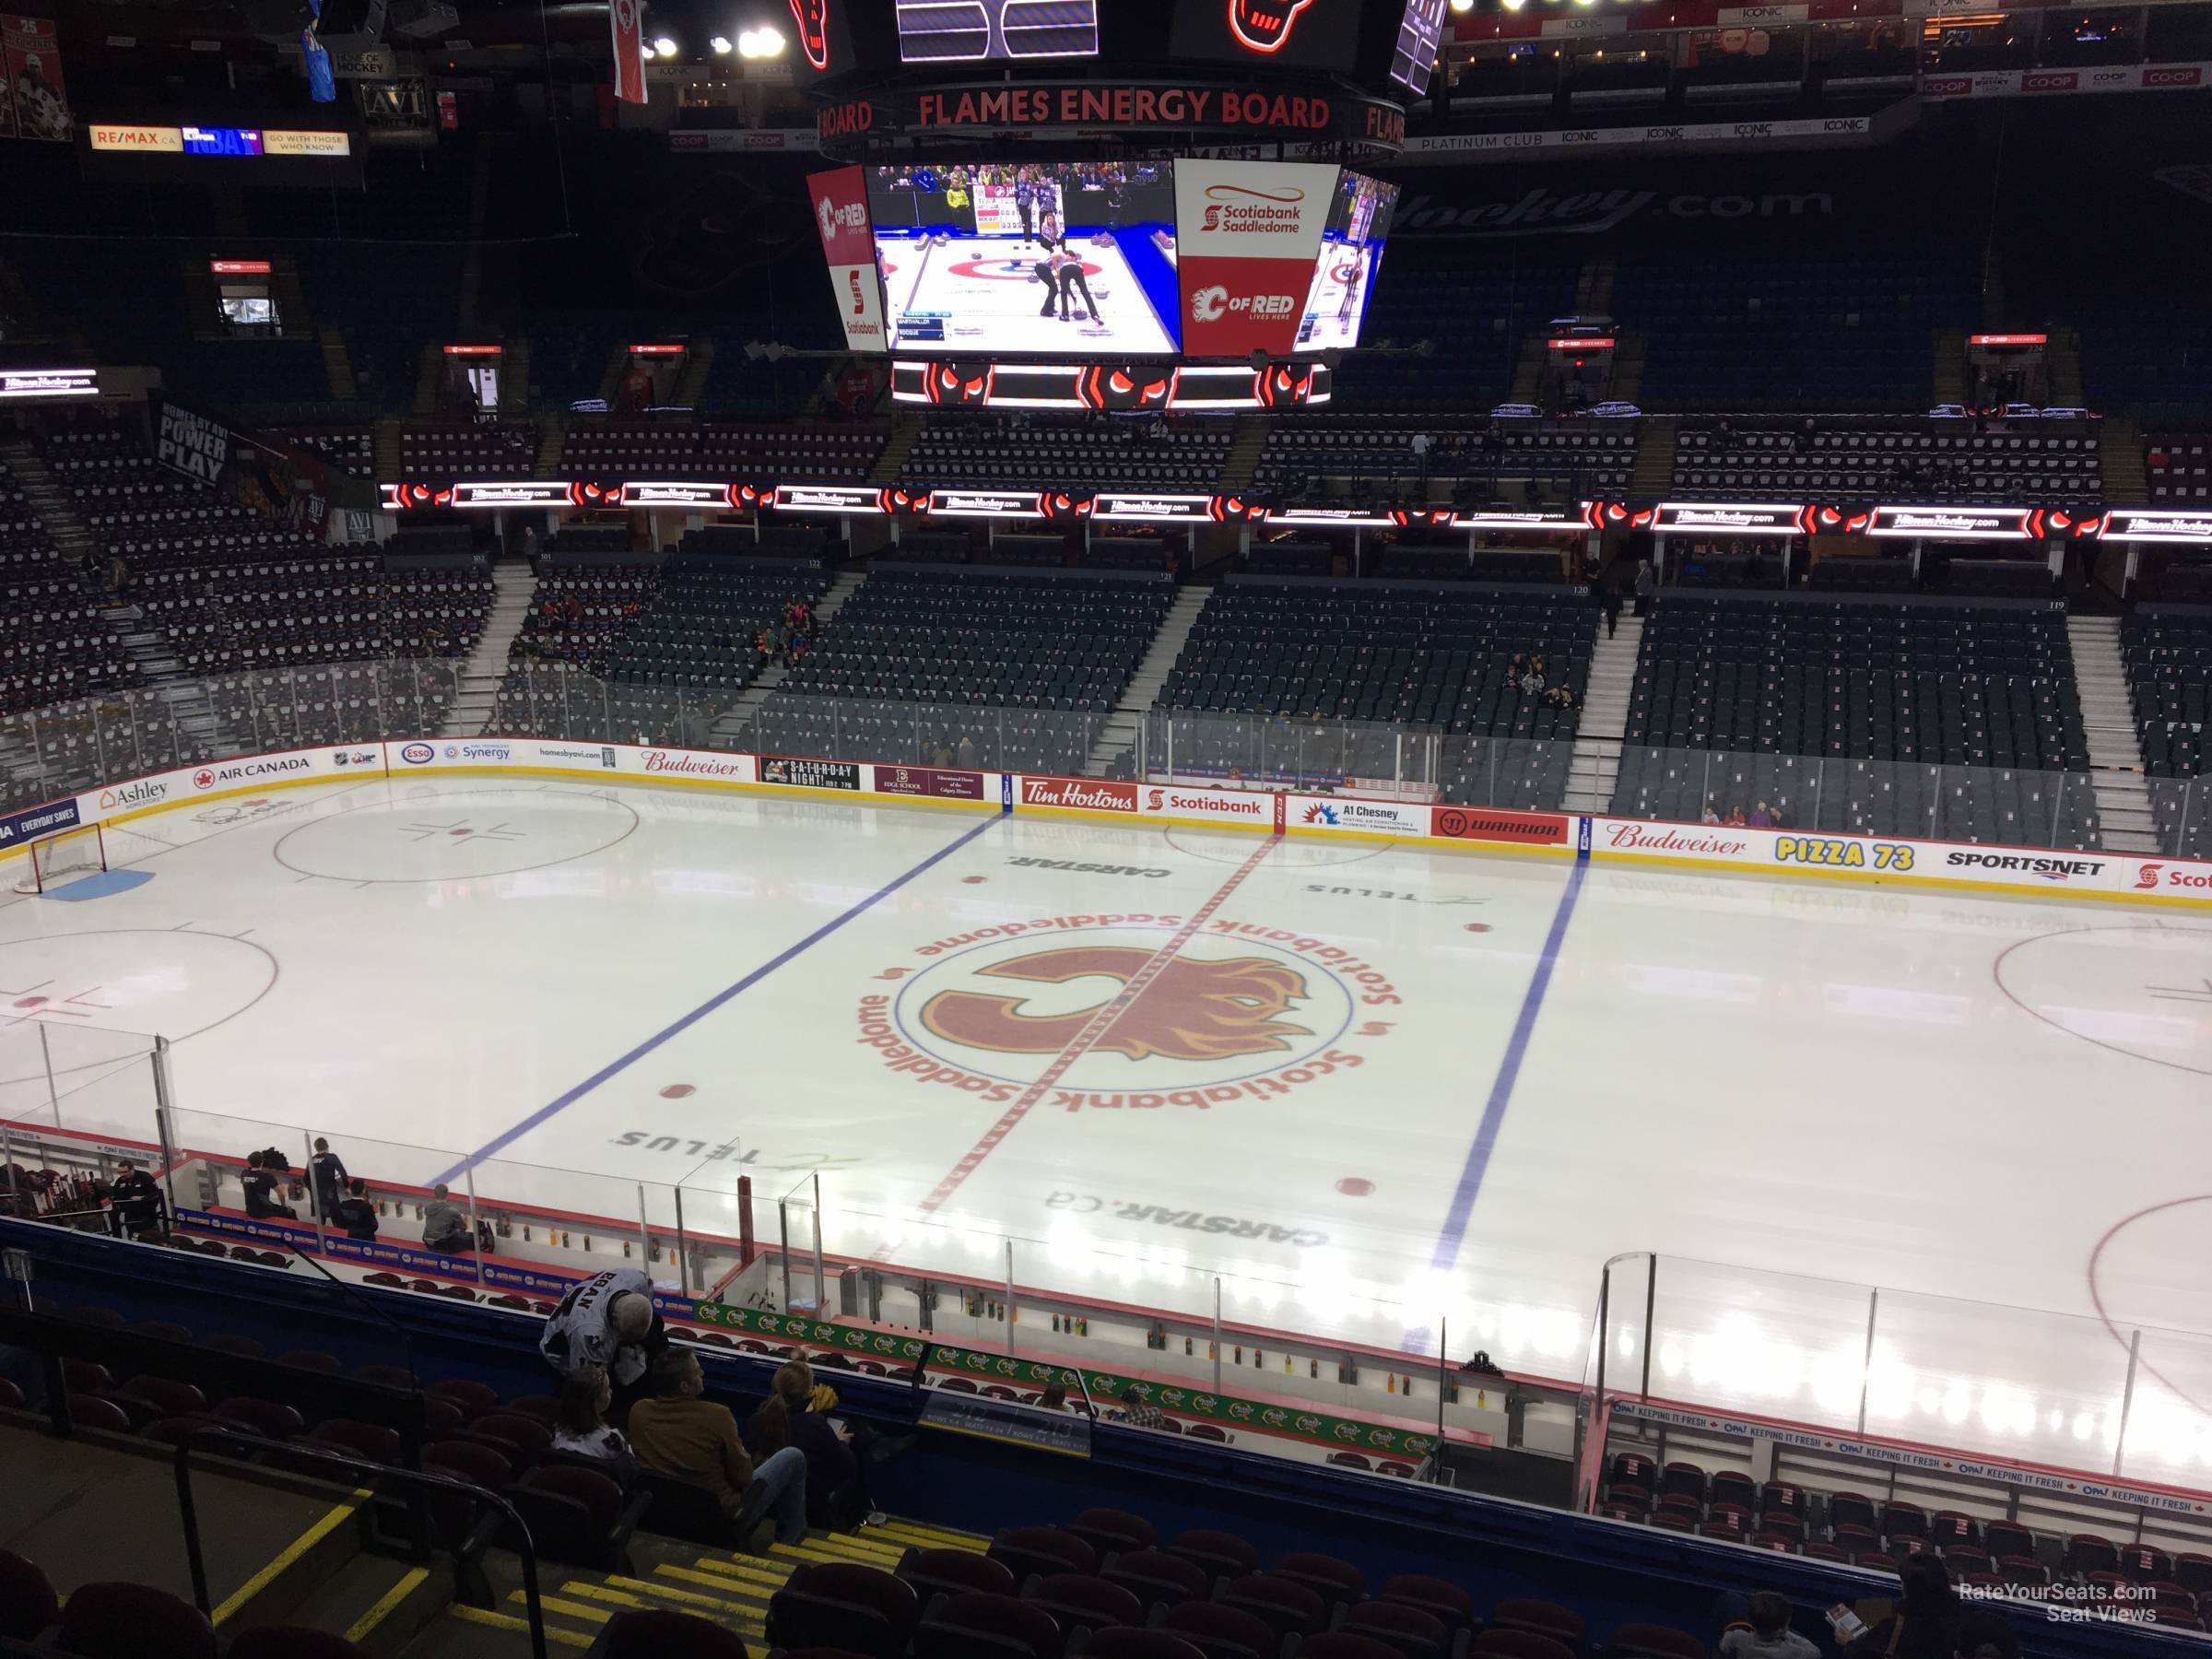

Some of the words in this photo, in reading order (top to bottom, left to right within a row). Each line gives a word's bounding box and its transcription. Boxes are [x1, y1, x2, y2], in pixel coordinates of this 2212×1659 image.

[1742, 6, 1783, 18] ICONIC
[20, 21, 37, 33] 25
[337, 63, 383, 73] HOCKEY
[2149, 72, 2194, 83] CO-OP
[2029, 76, 2072, 88] CO-OP
[821, 101, 872, 135] BOARD
[921, 89, 1050, 125] FLAMES
[1060, 88, 1211, 123] ENERGY
[1222, 91, 1331, 128] BOARD
[1647, 127, 1684, 138] ICONIC
[1735, 124, 1773, 135] ICONIC
[1824, 119, 1864, 131] ICONIC
[97, 131, 159, 145] RE/MAX
[269, 135, 283, 143] GO
[313, 135, 343, 144] THOSE
[1422, 137, 1497, 150] PLATINUM
[1503, 134, 1543, 147] CLUB
[1562, 131, 1599, 142] ICONIC
[835, 209, 846, 226] OF
[845, 202, 866, 228] RED
[1223, 205, 1301, 219] Scotiabank
[1223, 220, 1300, 233] Saddledome
[1229, 295, 1250, 312] OF
[1250, 294, 1295, 313] RED
[846, 321, 881, 335] Scotiabank
[159, 415, 227, 462] POWER
[197, 417, 210, 431] BY
[212, 422, 229, 439] AVI
[159, 437, 224, 482] PLAY
[406, 749, 429, 758] Esso
[463, 747, 510, 759] Synergy
[539, 748, 601, 760] homesbyavi.com
[641, 749, 739, 777] Budweiser
[218, 768, 233, 782] AIR
[236, 757, 311, 776] CANADA
[791, 771, 825, 786] NIGHT!
[117, 780, 168, 806] Ashley
[125, 796, 162, 809] HOMESTORE
[1026, 781, 1060, 805] Tim
[1063, 782, 1135, 810] Hortons
[1170, 794, 1262, 815] Scotiabank
[1343, 805, 1354, 816] A1
[1356, 806, 1399, 821] Chesney
[20, 814, 53, 833] EVERYDAY
[53, 807, 75, 823] SAVES
[1471, 818, 1559, 837] WARRIOR
[1606, 823, 1747, 855] Budweiser
[1775, 836, 1865, 867] PIZZA
[1873, 843, 1914, 871] 73
[1947, 852, 2105, 877] SPORTSNET
[1306, 884, 1417, 901] TELUS
[914, 912, 1182, 957] Saddledome
[1211, 919, 1403, 1006] Scotiabank
[856, 994, 1022, 1102] Saddledome
[1048, 1049, 1365, 1112] Scotiabank
[616, 1131, 760, 1165] TELUS
[1613, 1403, 1636, 1414] OPA!
[1638, 1408, 1670, 1422] KEEPING
[1671, 1413, 1679, 1423] IT
[1682, 1415, 1706, 1428] FRESH
[1037, 1420, 1073, 1439] 213
[1724, 1422, 1748, 1433] OPA!
[1751, 1428, 1783, 1441] KEEPING
[1785, 1432, 1794, 1442] IT
[1796, 1434, 1821, 1448] FRESH
[1839, 1442, 1863, 1453] OPA!
[1866, 1448, 1901, 1462] KEEPING
[1902, 1453, 1912, 1464] IT
[1913, 1455, 1940, 1468] FRESH
[1959, 1464, 1983, 1475] OPA!
[1986, 1468, 2023, 1483] KEEPING
[2025, 1475, 2033, 1484] IT
[2036, 1477, 2064, 1490] FRESH
[2083, 1485, 2109, 1497] OPA!
[2112, 1489, 2149, 1504] KEEPING
[2151, 1496, 2159, 1506] IT
[2162, 1499, 2191, 1512] FRESH
